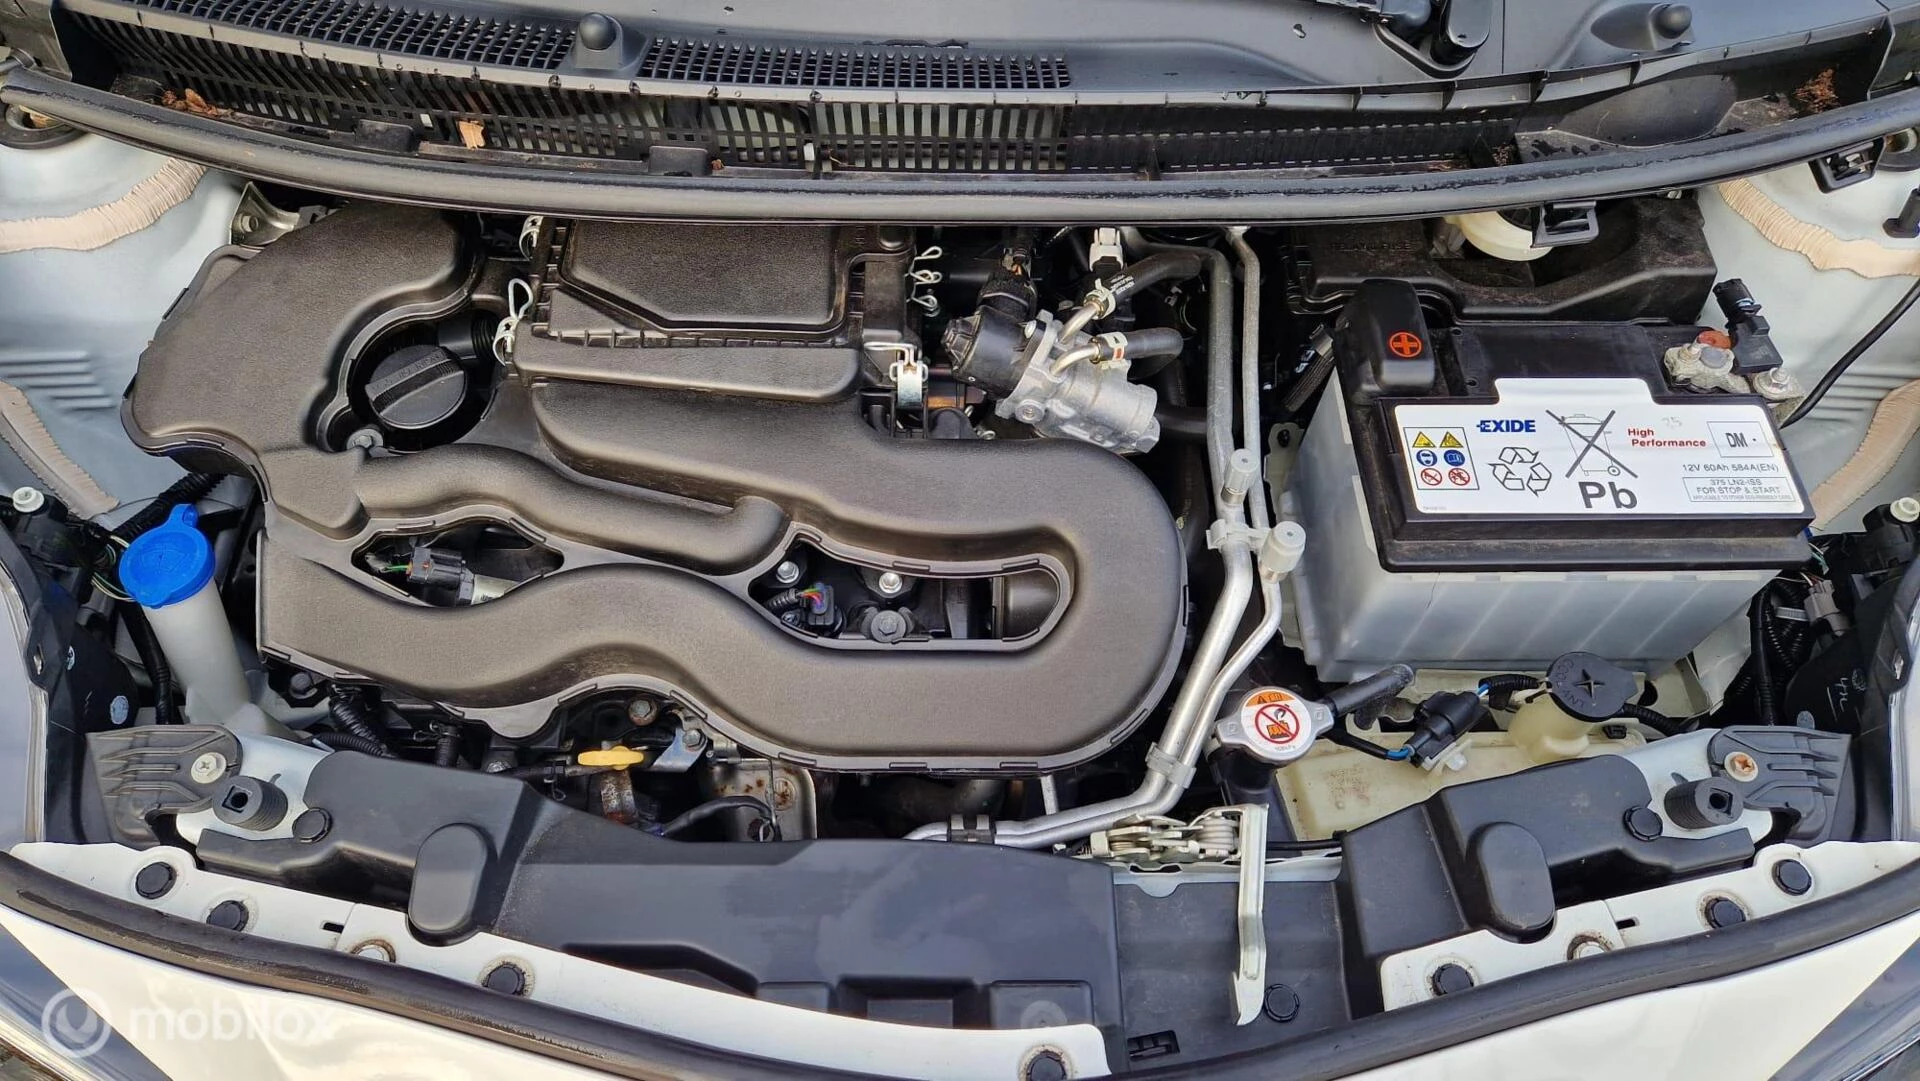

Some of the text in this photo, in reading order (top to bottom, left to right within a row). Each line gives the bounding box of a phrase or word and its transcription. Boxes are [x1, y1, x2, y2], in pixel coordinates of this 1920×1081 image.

[1477, 419, 1537, 433] EXIDE
[1627, 428, 1654, 438] High
[1631, 438, 1707, 447] Performance
[1725, 432, 1748, 448] DM
[1683, 463, 1700, 472] 12V
[1703, 463, 1730, 472] 60Ah
[1578, 481, 1638, 509] Pb
